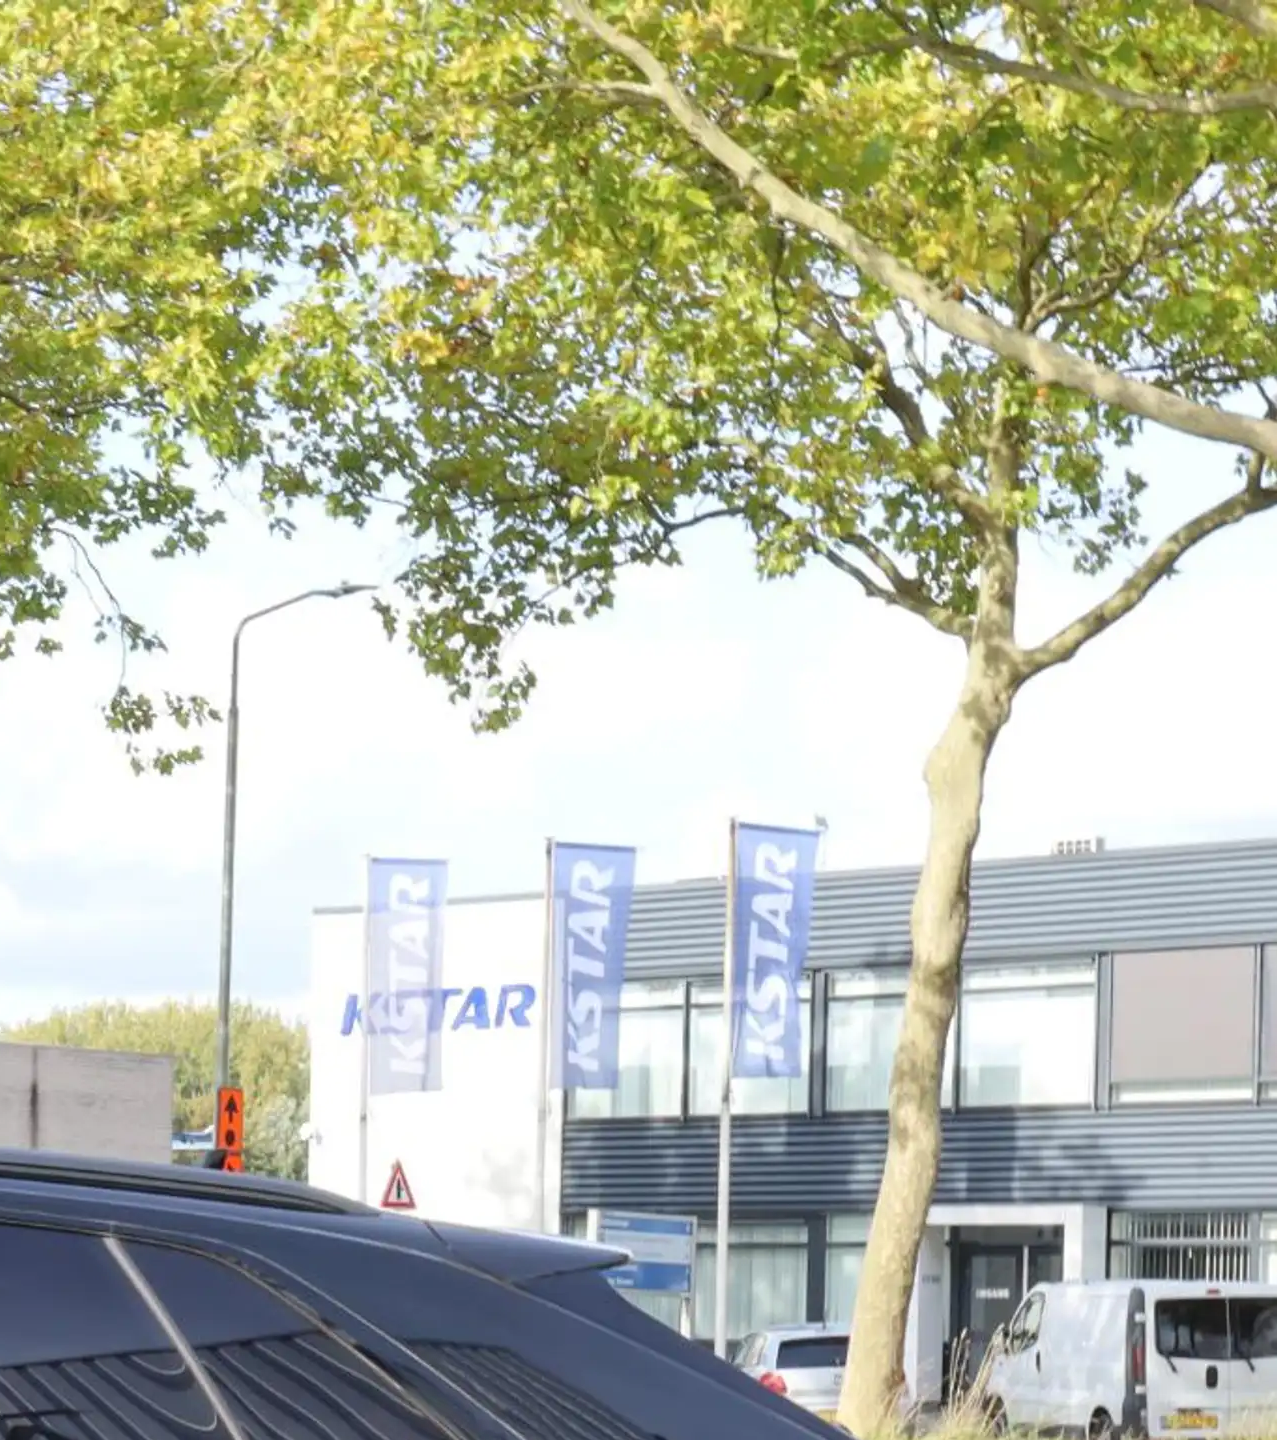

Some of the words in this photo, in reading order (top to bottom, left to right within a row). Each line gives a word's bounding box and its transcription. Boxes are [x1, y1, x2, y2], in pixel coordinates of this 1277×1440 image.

[389, 872, 431, 1074] KSTAR
[566, 860, 616, 1073] KSTAR
[745, 842, 797, 1062] KSTAR
